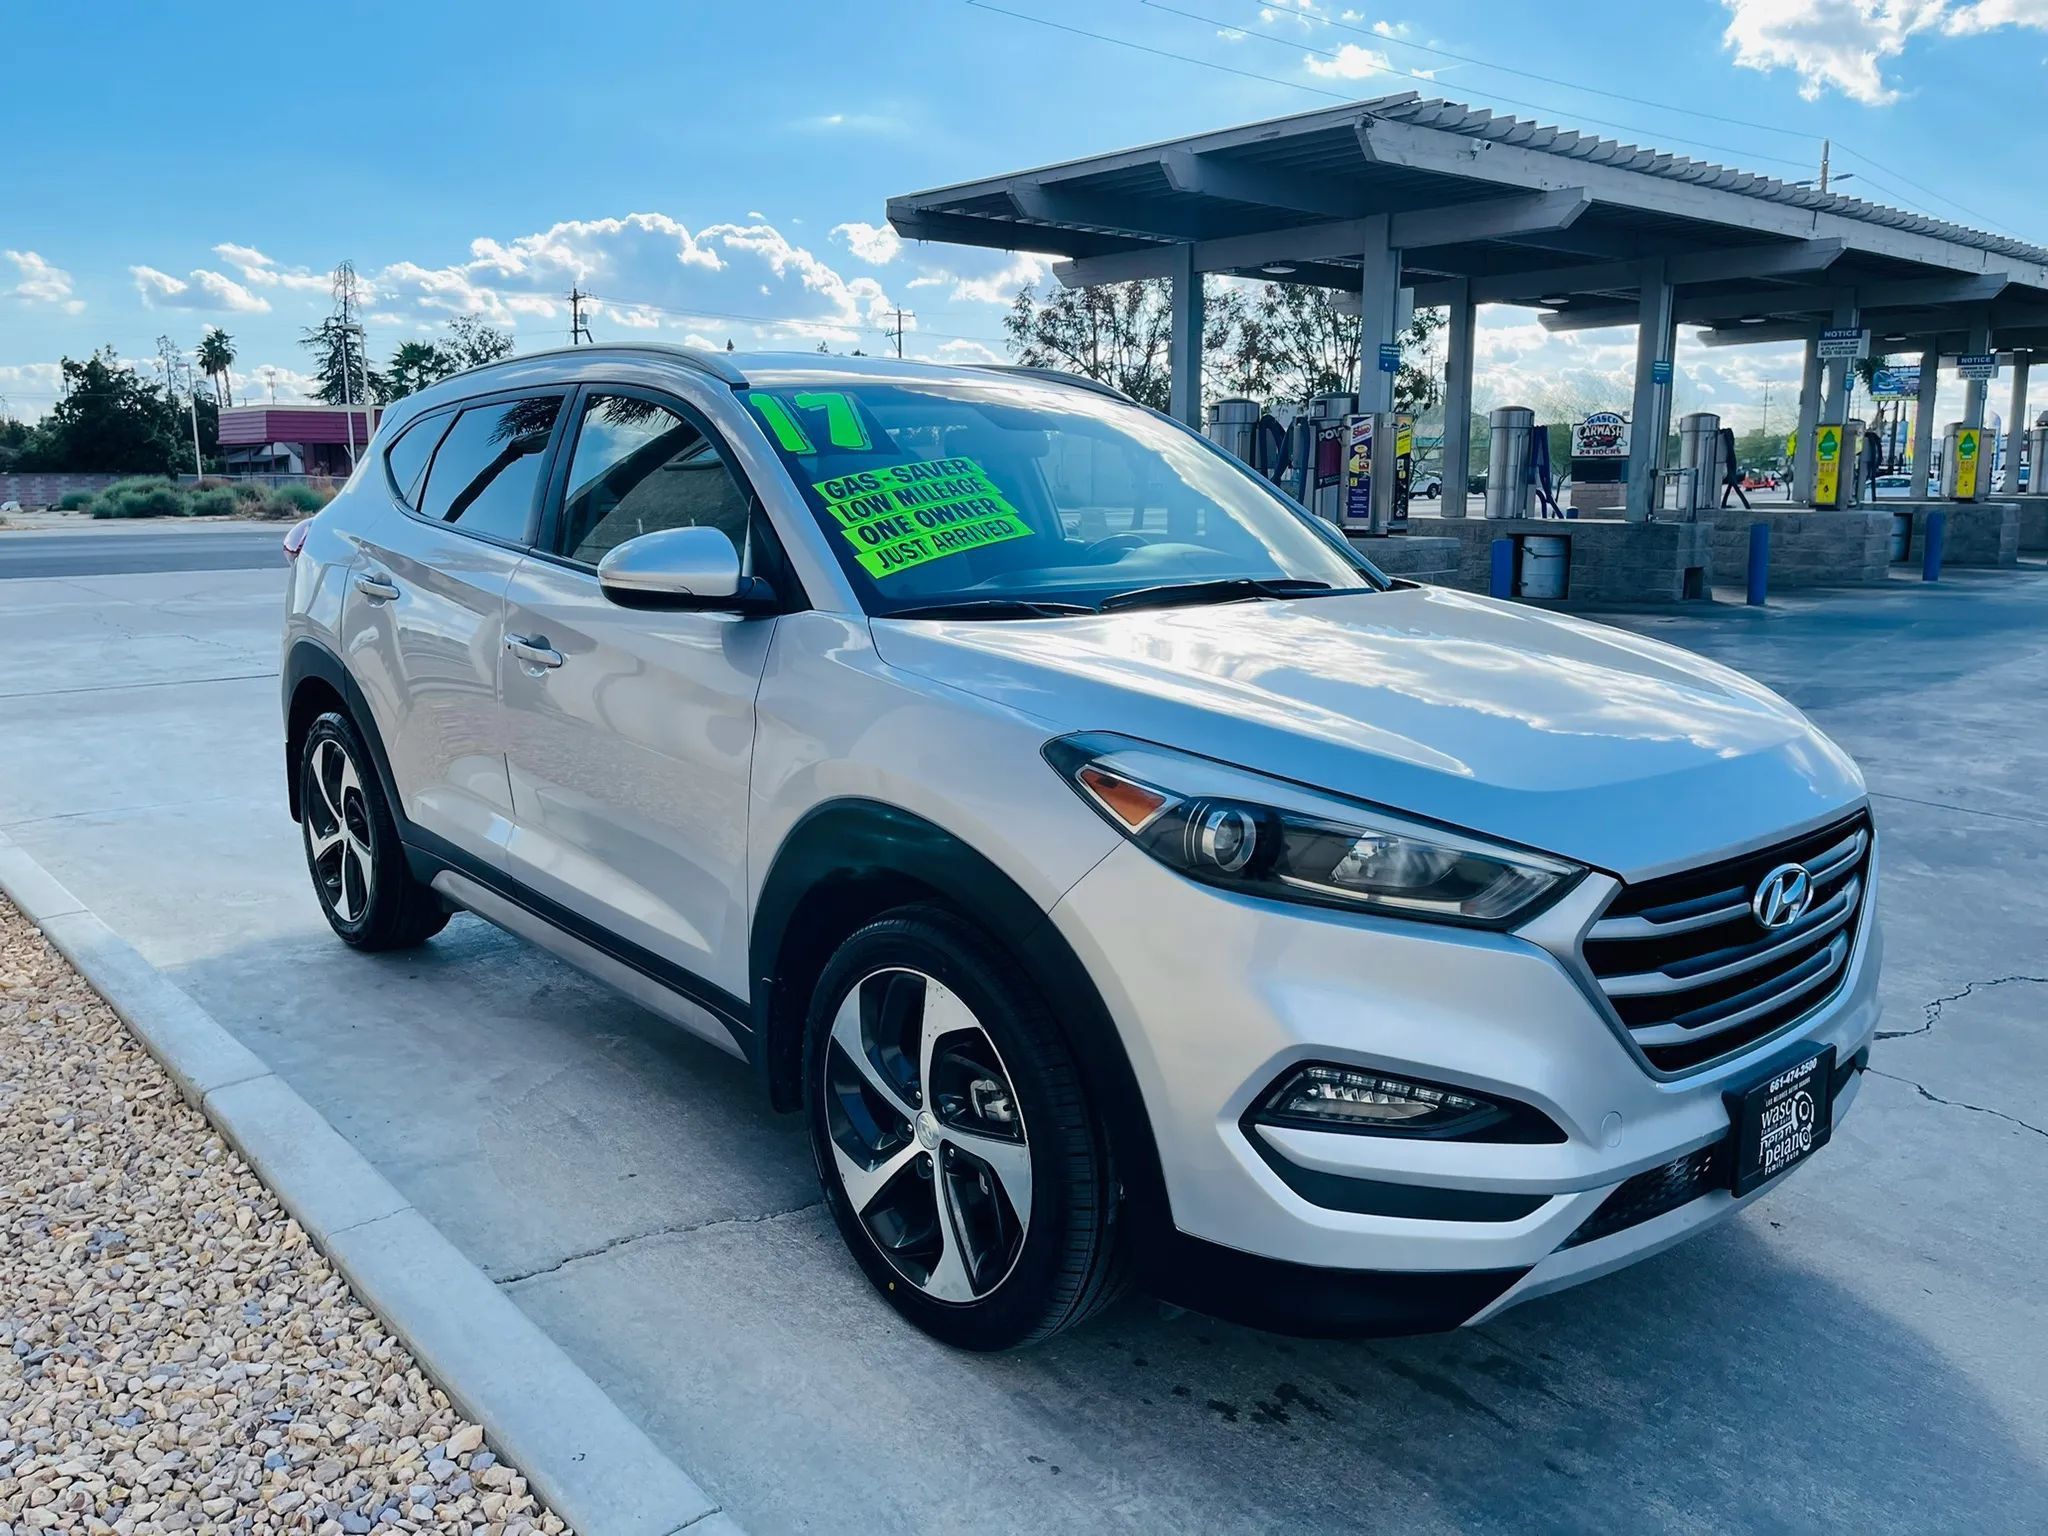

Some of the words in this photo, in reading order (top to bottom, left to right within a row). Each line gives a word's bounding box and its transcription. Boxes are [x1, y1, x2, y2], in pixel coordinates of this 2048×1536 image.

[1824, 330, 1858, 338] NOTICE
[749, 392, 872, 455] 17
[1577, 424, 1624, 439] CARWASH
[824, 473, 881, 499] GAS
[890, 459, 973, 483] SAVER
[837, 494, 893, 522] LOW
[892, 477, 986, 508] MILEAGE
[858, 515, 915, 545] ONE
[914, 498, 1000, 528] OWNER
[876, 539, 929, 569] JUST
[930, 519, 1015, 551] ARRIVED
[1764, 1158, 1785, 1176] Family
[1786, 1149, 1799, 1163] Auto
